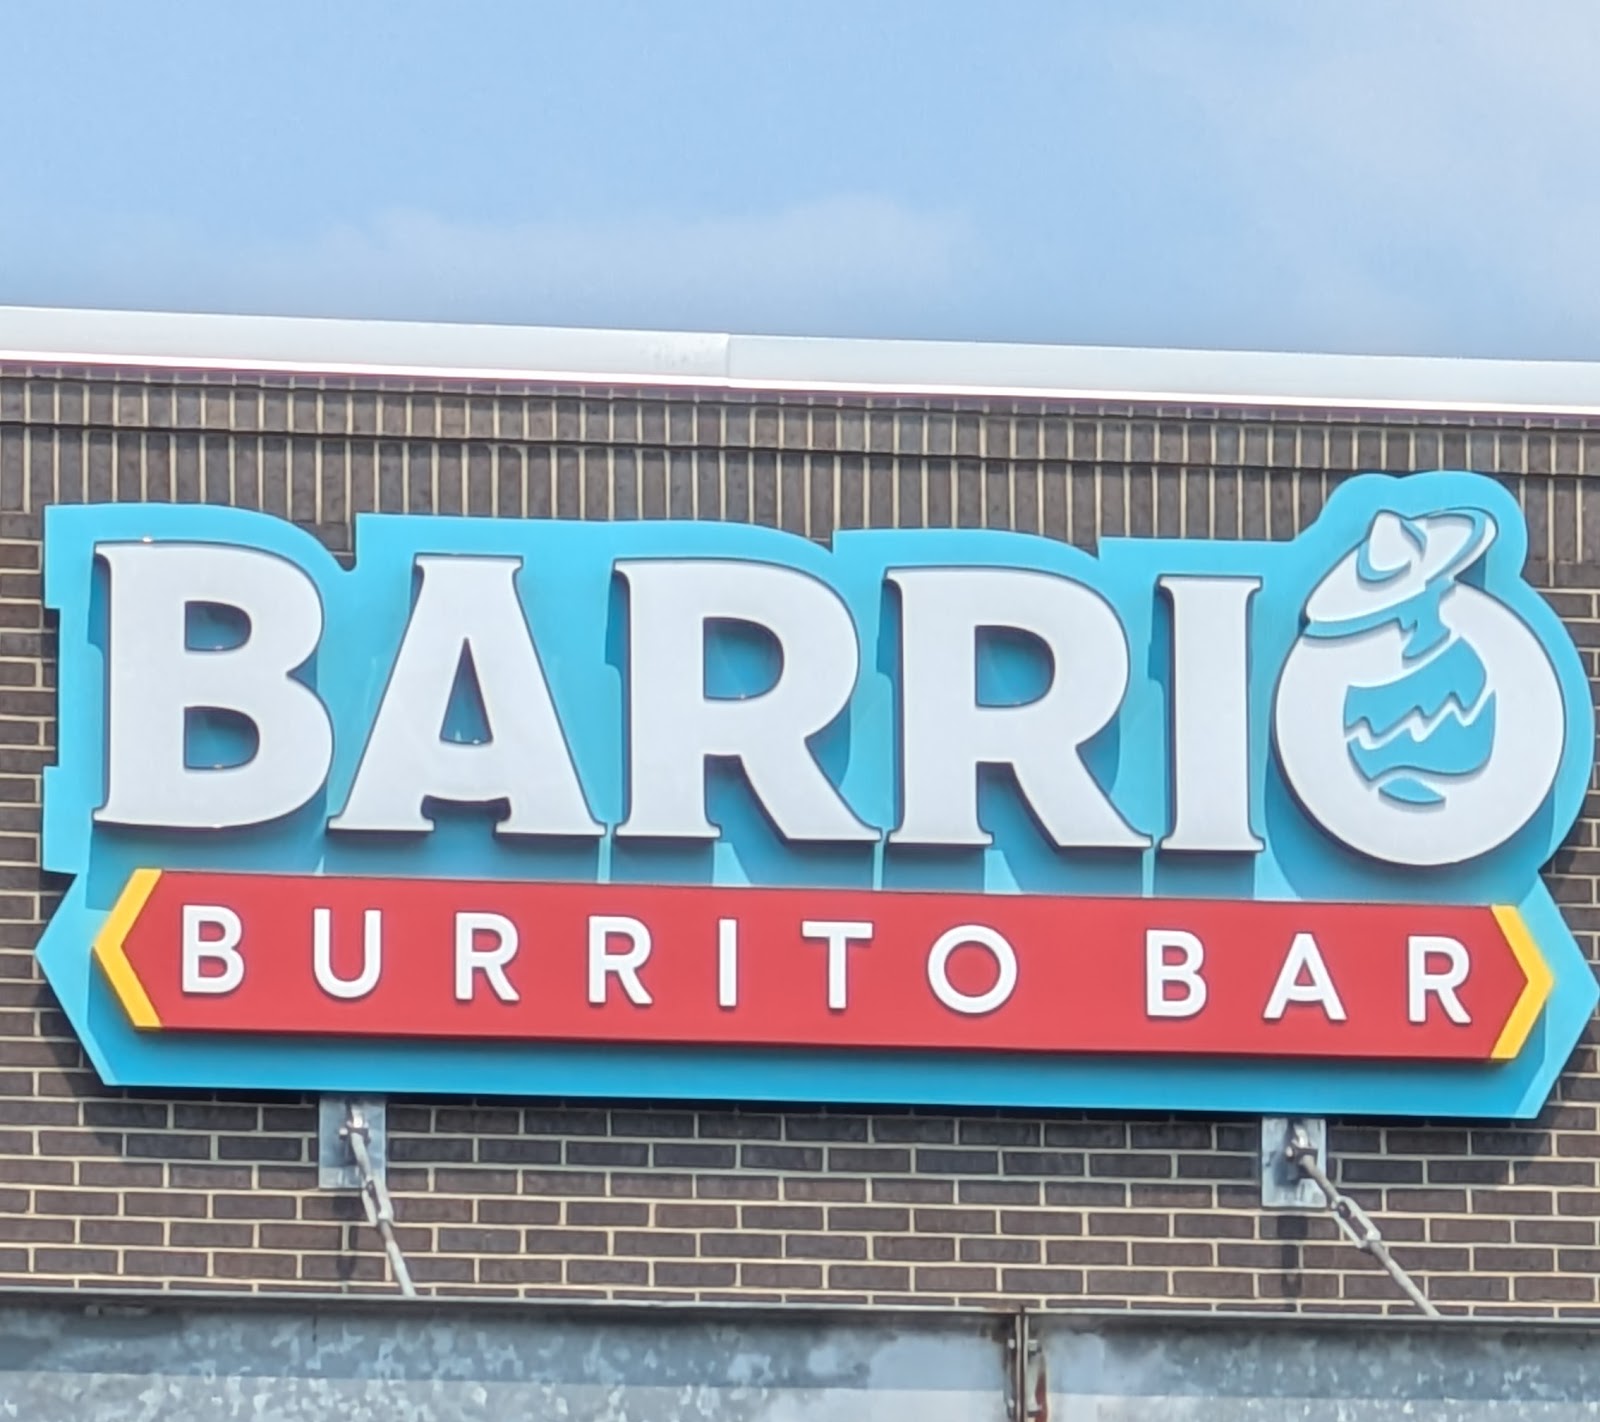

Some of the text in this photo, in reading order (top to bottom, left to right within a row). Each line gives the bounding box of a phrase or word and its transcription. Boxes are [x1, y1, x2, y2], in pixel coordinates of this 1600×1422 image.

[92, 507, 1566, 866] BARRIO
[181, 903, 1472, 1024] BURRITO BAR
